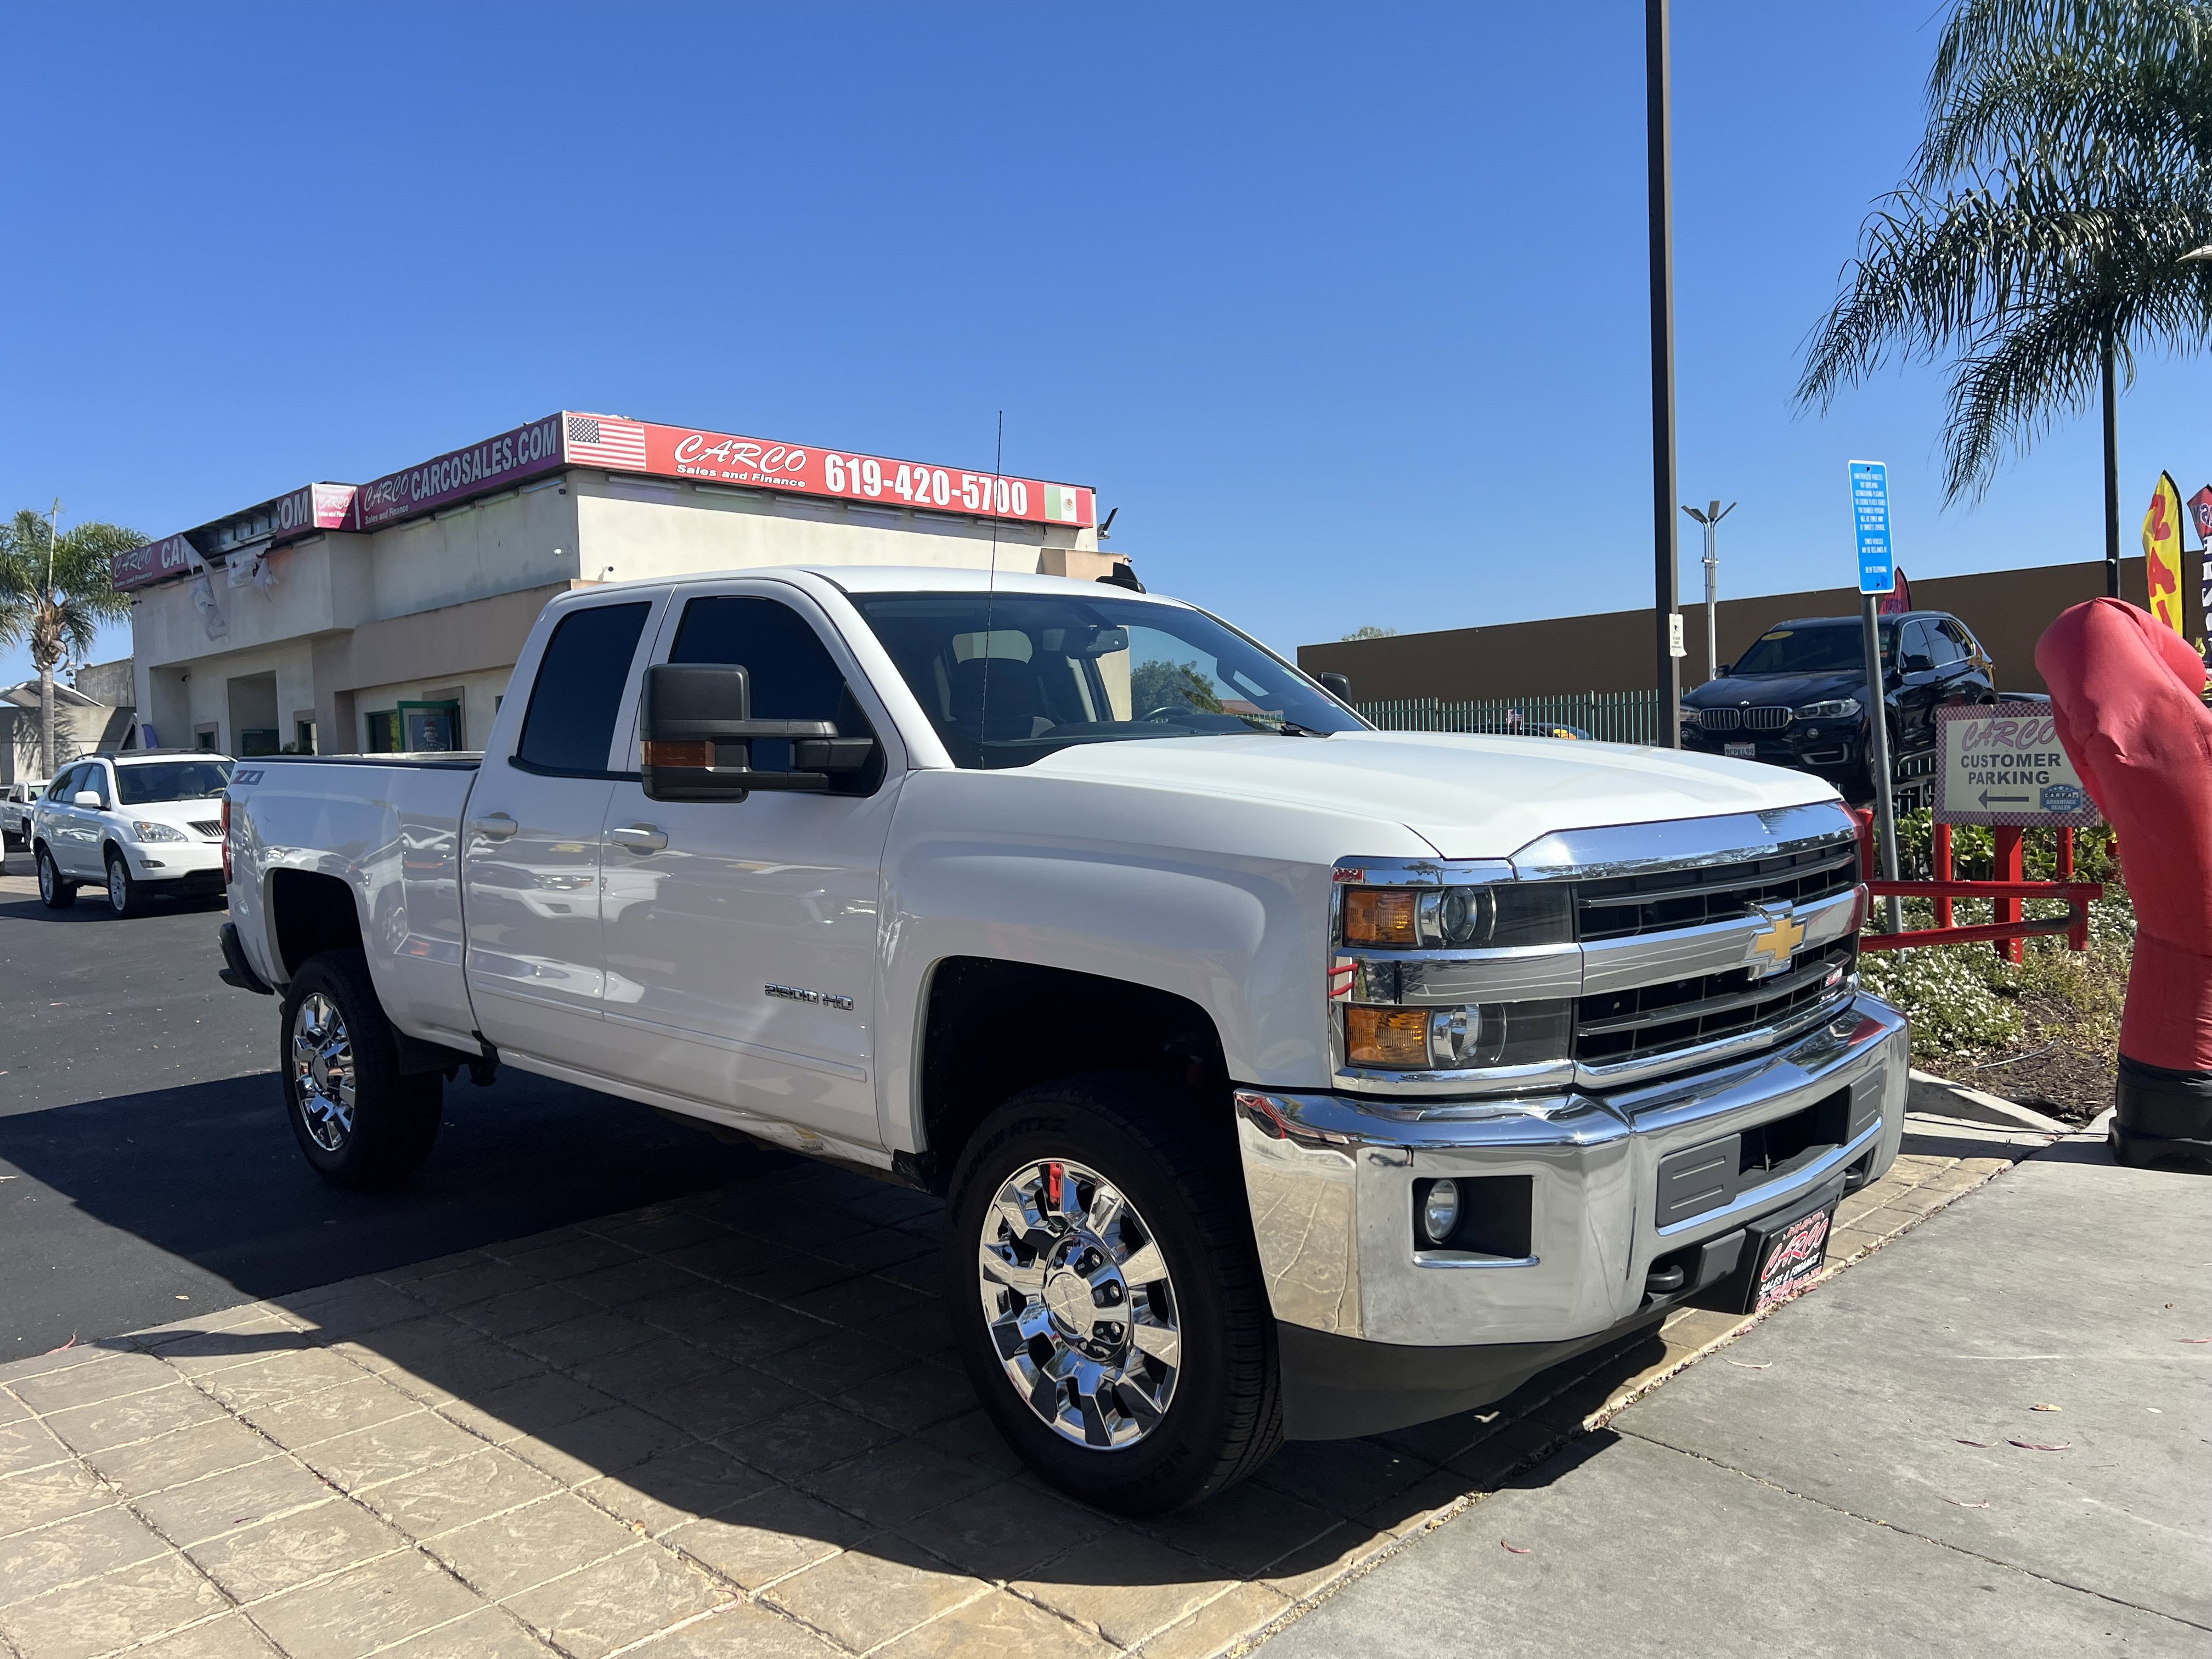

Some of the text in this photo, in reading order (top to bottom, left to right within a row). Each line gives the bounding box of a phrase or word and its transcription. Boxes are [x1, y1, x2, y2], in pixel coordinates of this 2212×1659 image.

[411, 420, 557, 502] CARCOSALES.COM
[674, 434, 806, 473] CARCO
[364, 473, 409, 512] CARCO
[676, 464, 806, 488] Sales and Finance
[825, 454, 1028, 516] 619-420-5700
[365, 504, 409, 525] Sales and Finance
[114, 546, 152, 578] CARCO
[1961, 719, 2056, 752] CARCO
[1961, 753, 2061, 768] CUSTOMER
[1968, 771, 2050, 785] PARKING
[765, 983, 854, 1011] 2500 HD
[1760, 1217, 1829, 1283] CARCO
[1759, 1273, 1784, 1295] SALES
[1790, 1251, 1820, 1277] FINANCE
